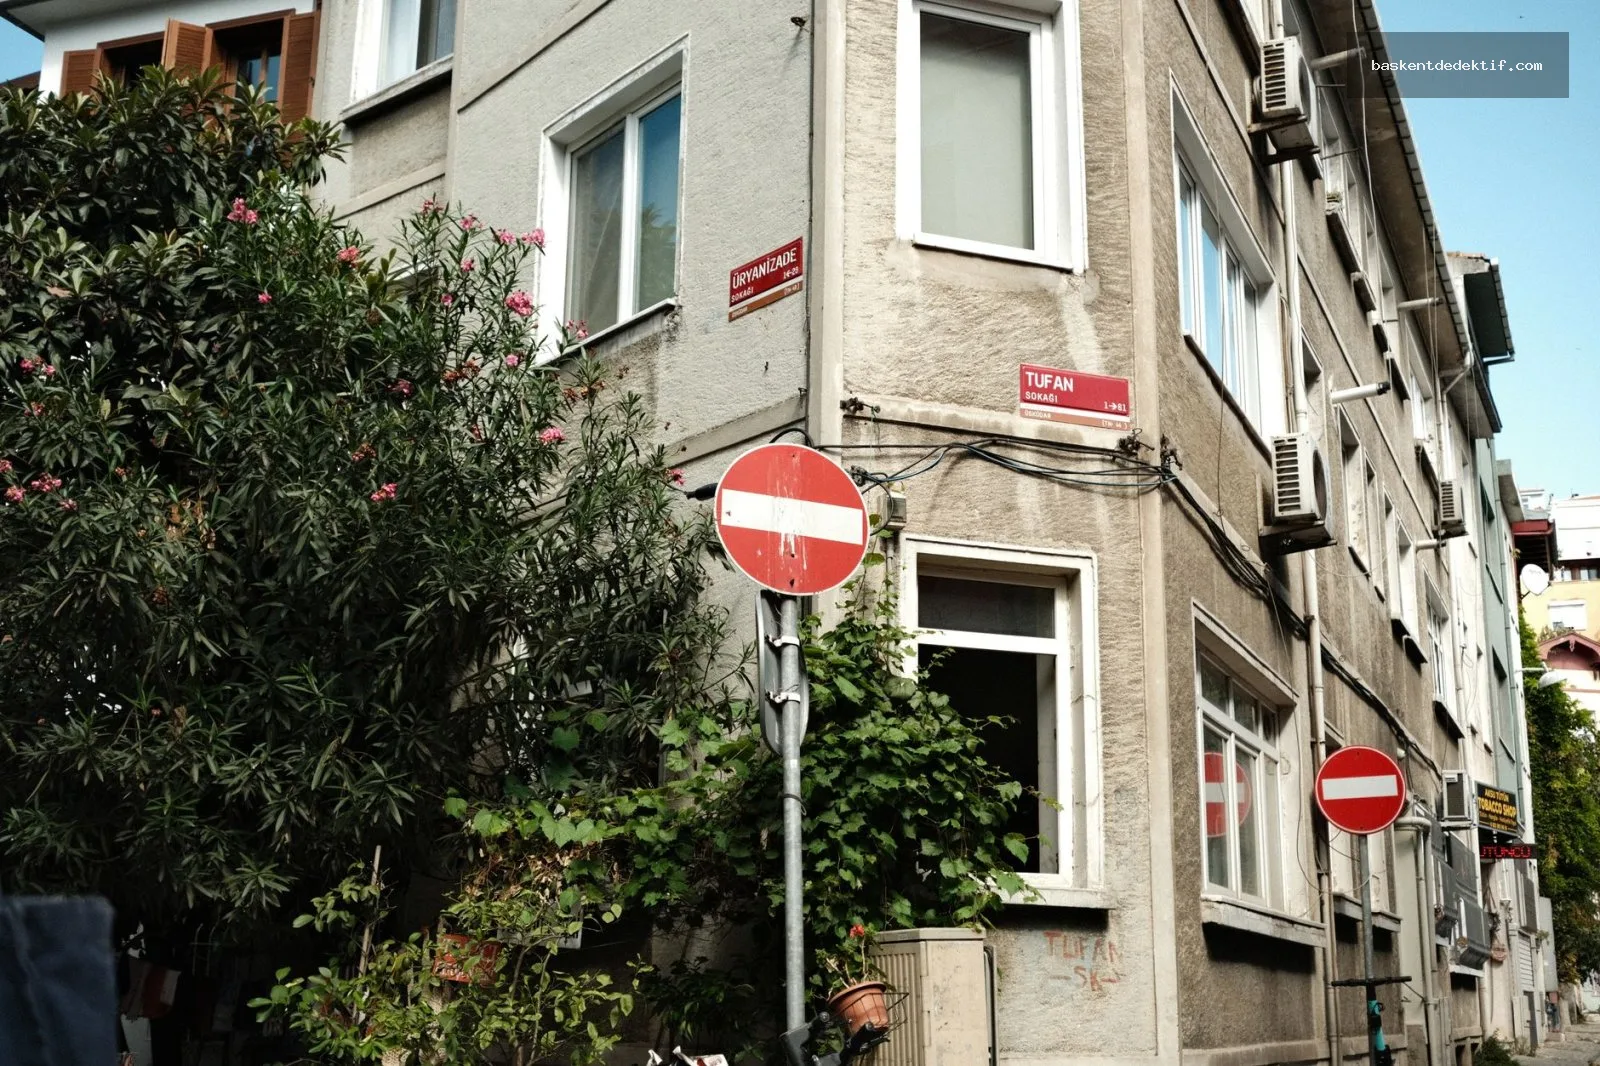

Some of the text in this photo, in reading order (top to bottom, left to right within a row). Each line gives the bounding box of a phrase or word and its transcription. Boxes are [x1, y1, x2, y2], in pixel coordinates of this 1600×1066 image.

[732, 247, 797, 289] ÜRYANİZADE
[731, 286, 754, 303] SOKAĞI
[1025, 371, 1074, 392] TUFAN
[1025, 391, 1058, 403] SOKAĞI
[1478, 797, 1517, 818] TOBACCO SHOP
